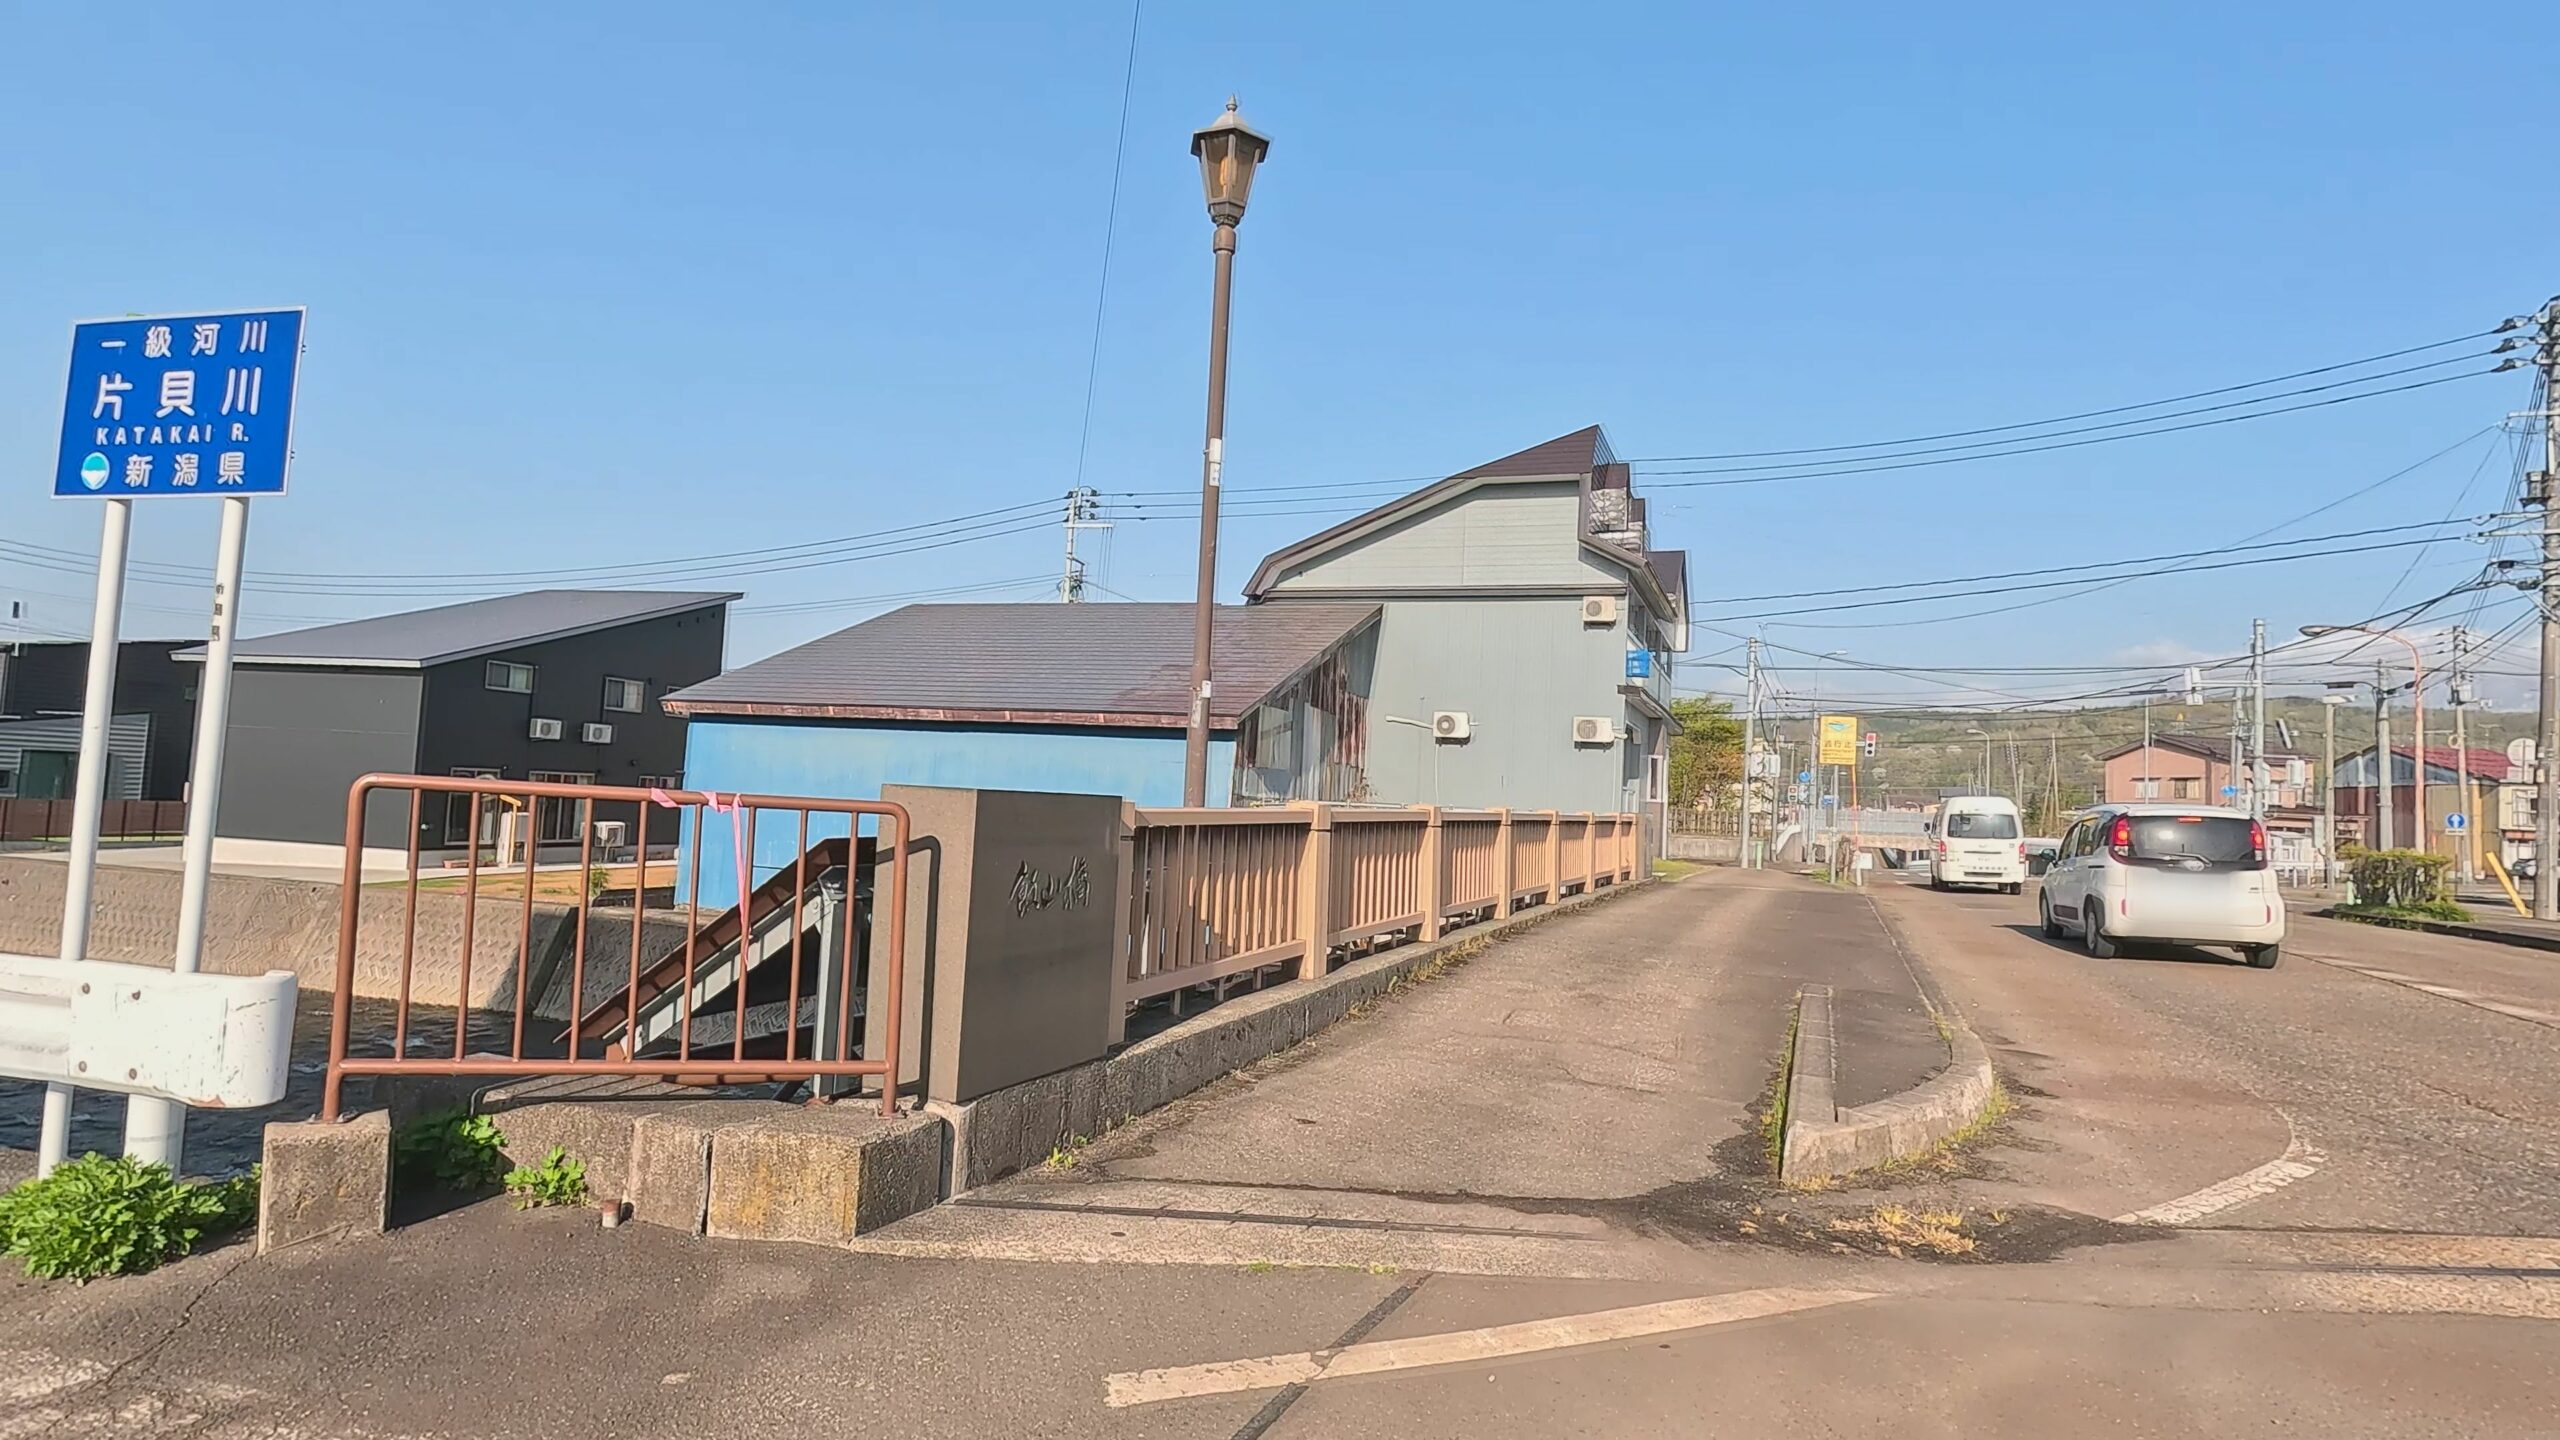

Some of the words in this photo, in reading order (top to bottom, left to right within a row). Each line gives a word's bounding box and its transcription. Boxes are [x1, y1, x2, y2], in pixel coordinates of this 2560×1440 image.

[100, 320, 267, 358] 一級河川
[93, 366, 262, 421] 片貝川
[96, 424, 212, 445] KATAKAI
[231, 423, 249, 442] R.
[125, 452, 245, 488] 新潟県
